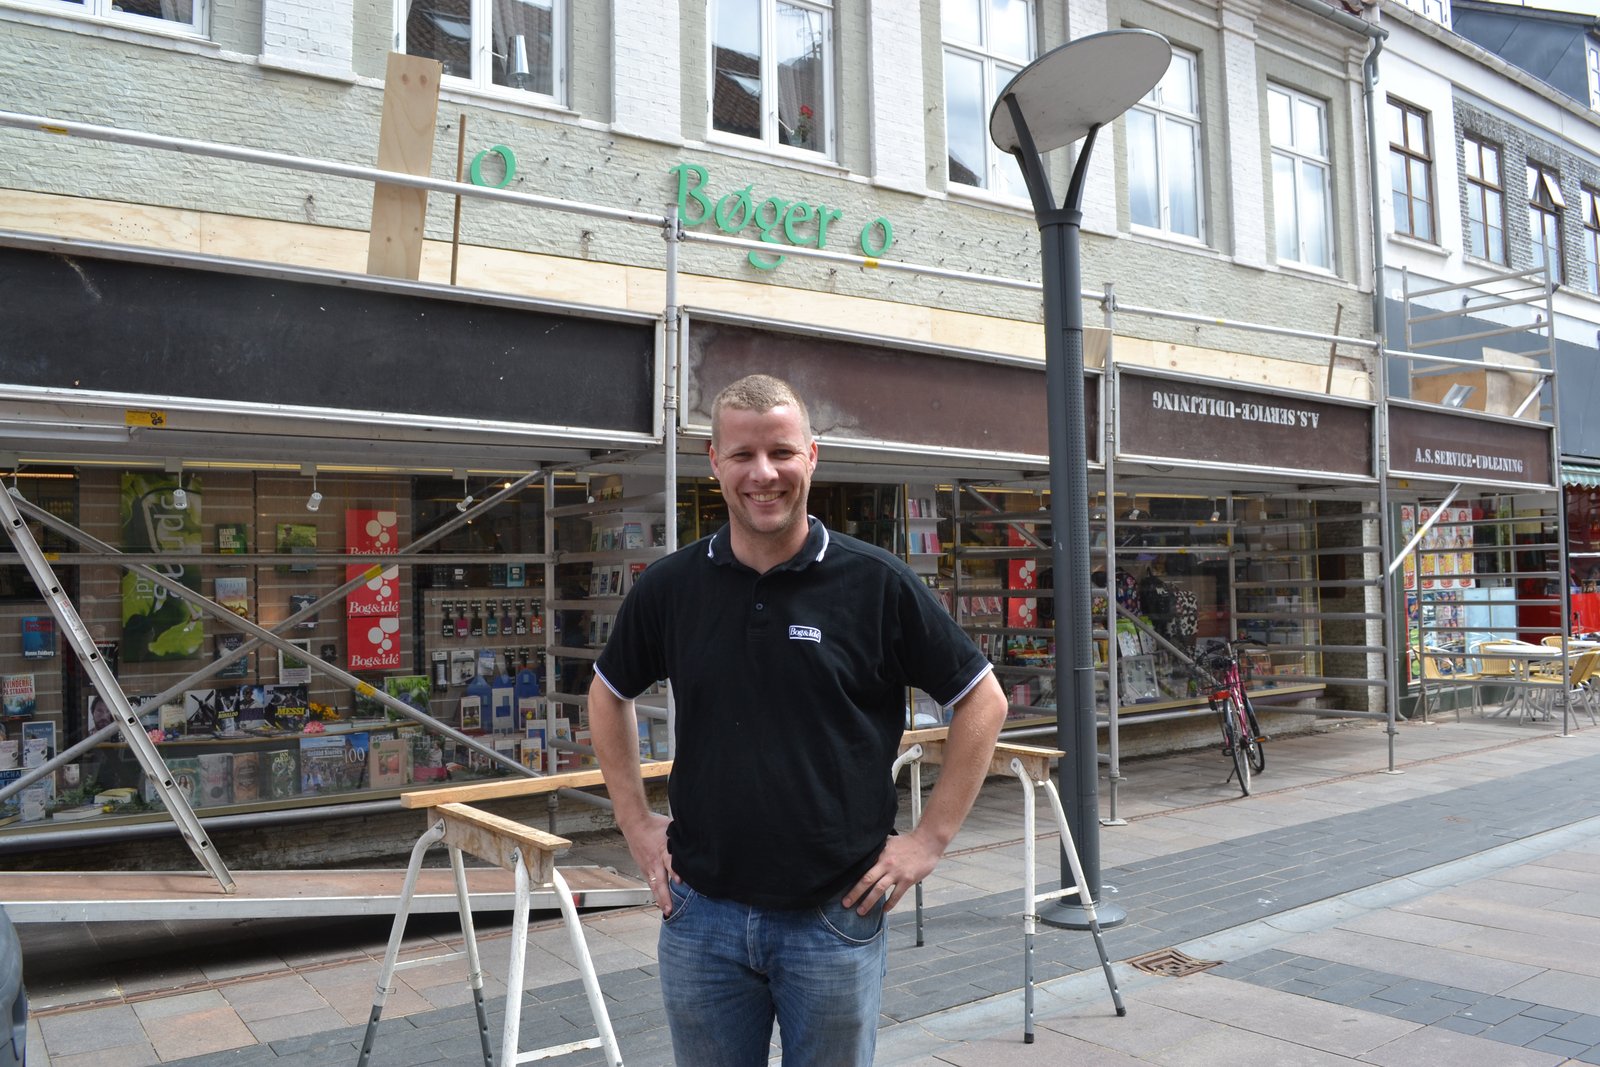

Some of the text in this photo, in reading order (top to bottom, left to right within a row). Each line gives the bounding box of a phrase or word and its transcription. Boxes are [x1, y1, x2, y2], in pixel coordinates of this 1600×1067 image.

[669, 163, 843, 270] Bøger
[861, 217, 893, 257] o
[1152, 391, 1320, 429] A.S. SERVICE-UDLEJNING
[1415, 448, 1434, 464] A.S.
[349, 600, 399, 615] Bog&idé
[351, 653, 399, 667] Bog&idé
[277, 707, 305, 716] MESSI
[344, 747, 365, 763] 100
